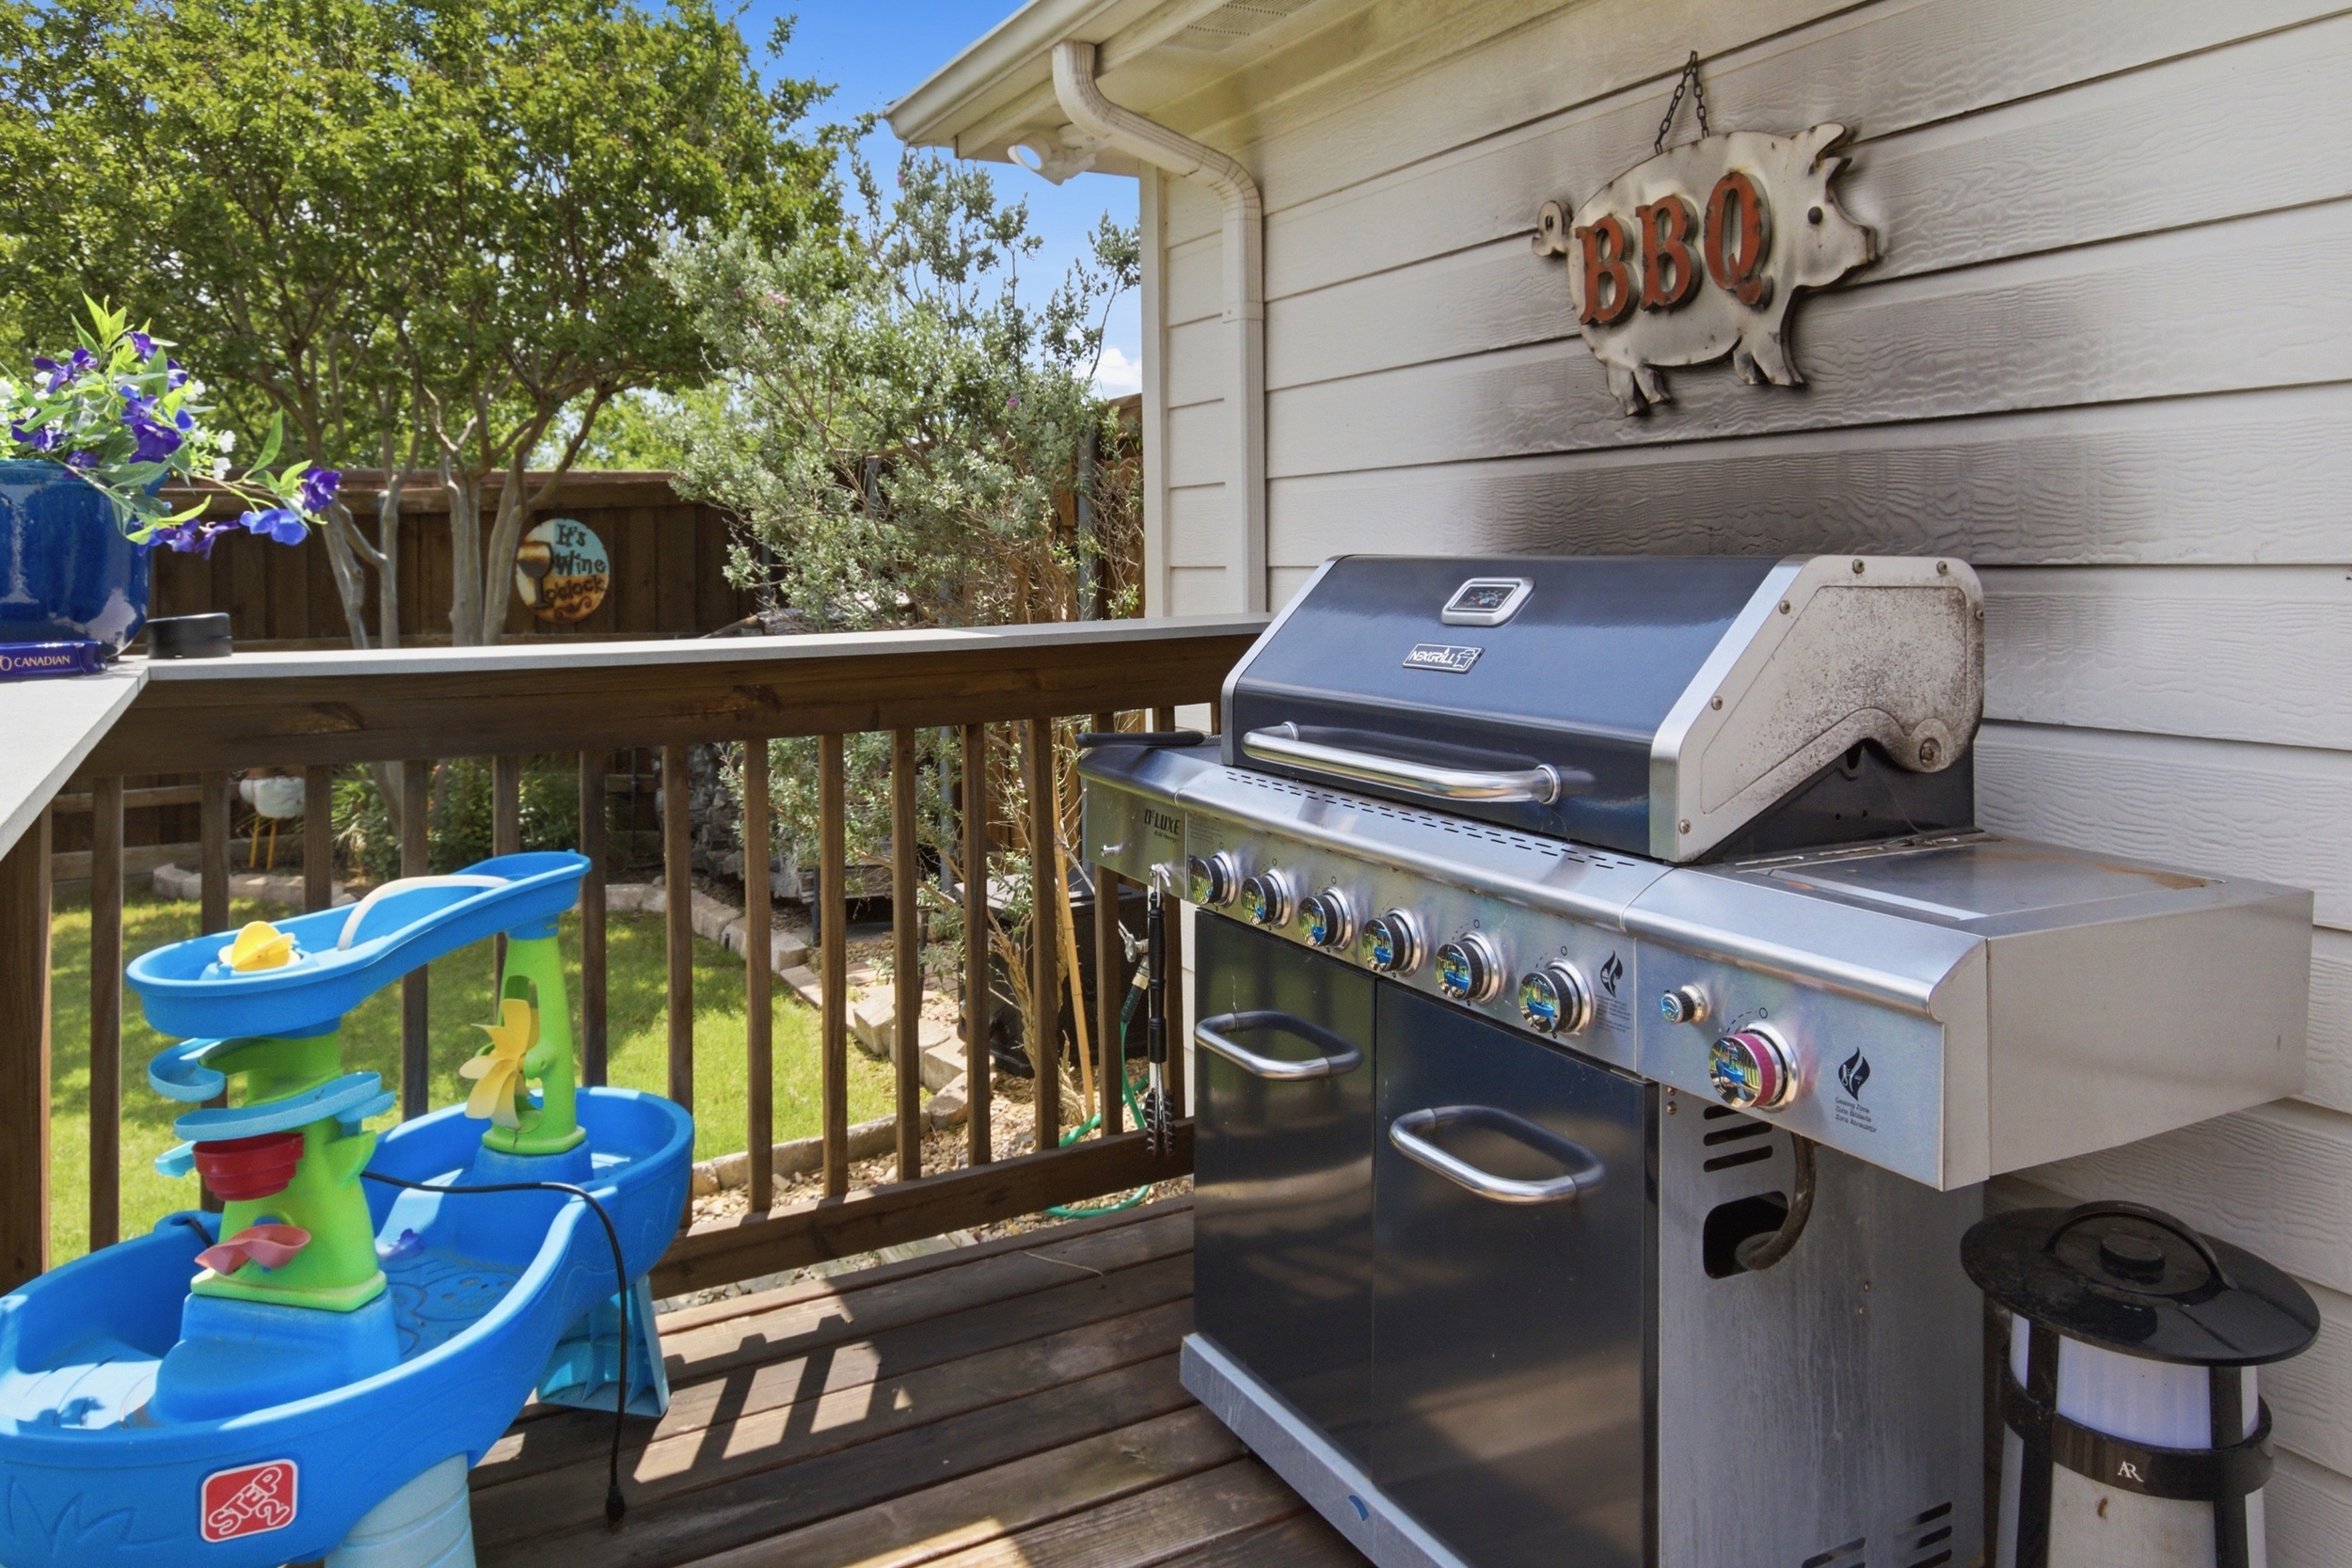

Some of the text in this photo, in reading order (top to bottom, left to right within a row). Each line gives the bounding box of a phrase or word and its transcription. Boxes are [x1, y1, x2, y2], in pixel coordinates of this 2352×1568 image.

[1575, 172, 1772, 325] BBQ
[556, 523, 586, 547] It's
[555, 550, 607, 576] Wine
[14, 656, 71, 668] CANADIAN
[1408, 647, 1455, 664] NEXGRILL
[208, 1466, 282, 1536] STEP
[255, 1498, 290, 1527] 2
